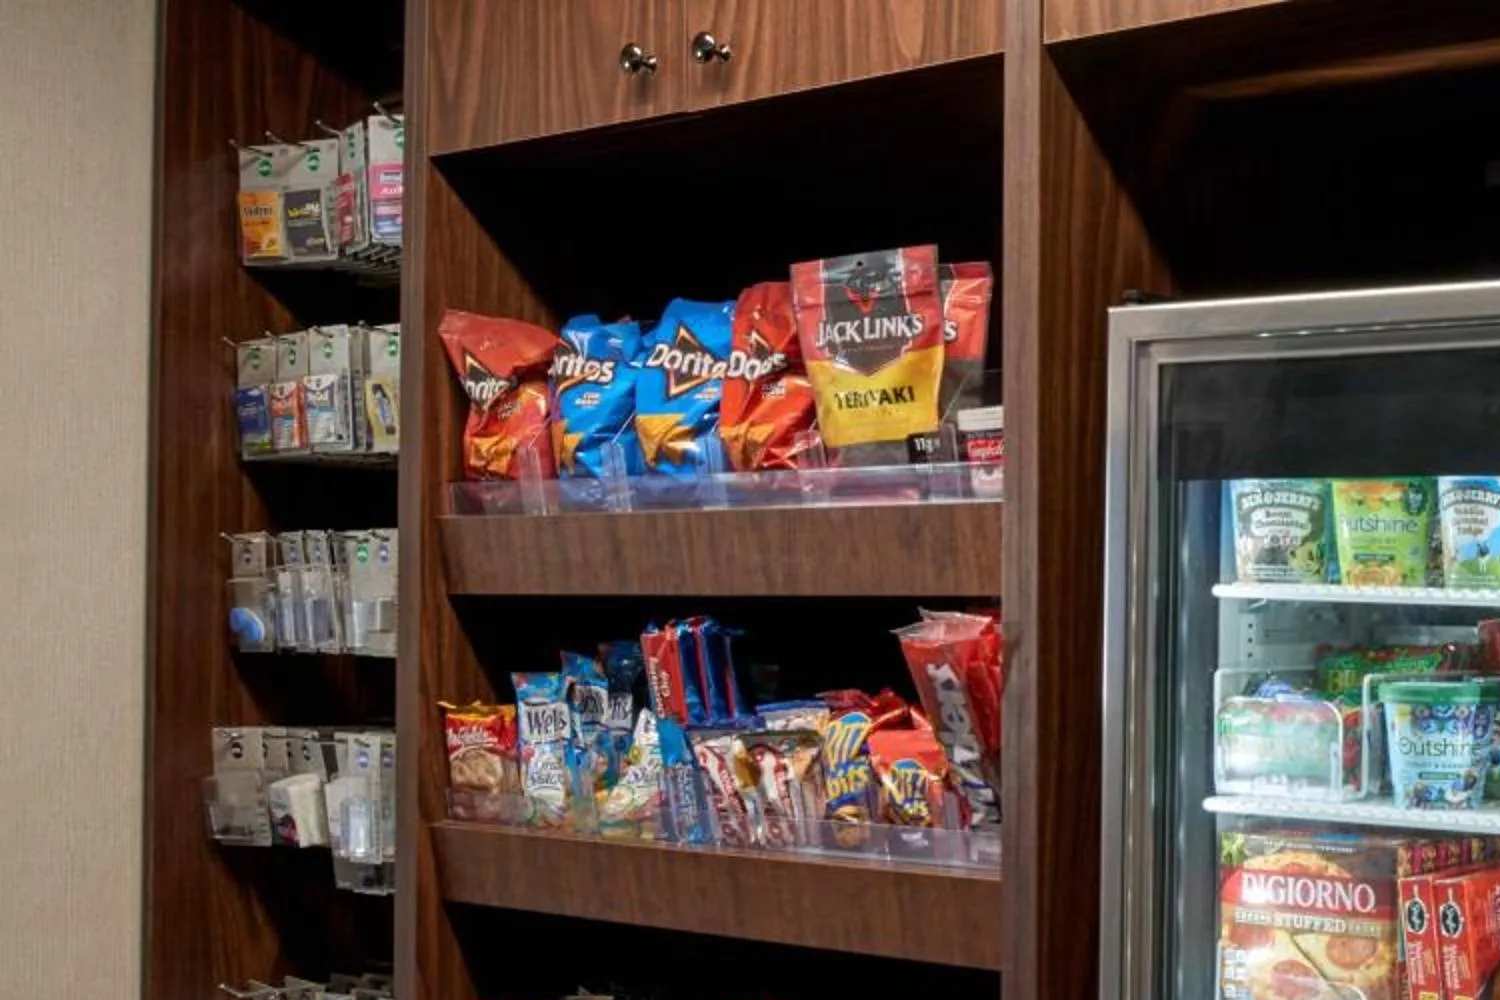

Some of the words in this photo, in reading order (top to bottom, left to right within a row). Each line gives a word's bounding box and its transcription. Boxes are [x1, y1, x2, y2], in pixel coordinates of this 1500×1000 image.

[815, 319, 862, 348] JACK
[549, 353, 617, 385] ritos
[646, 343, 729, 382] Dorito
[833, 386, 916, 411] TERIYAKI
[1338, 514, 1419, 534] utshine
[1241, 870, 1375, 913] DIGIORNO
